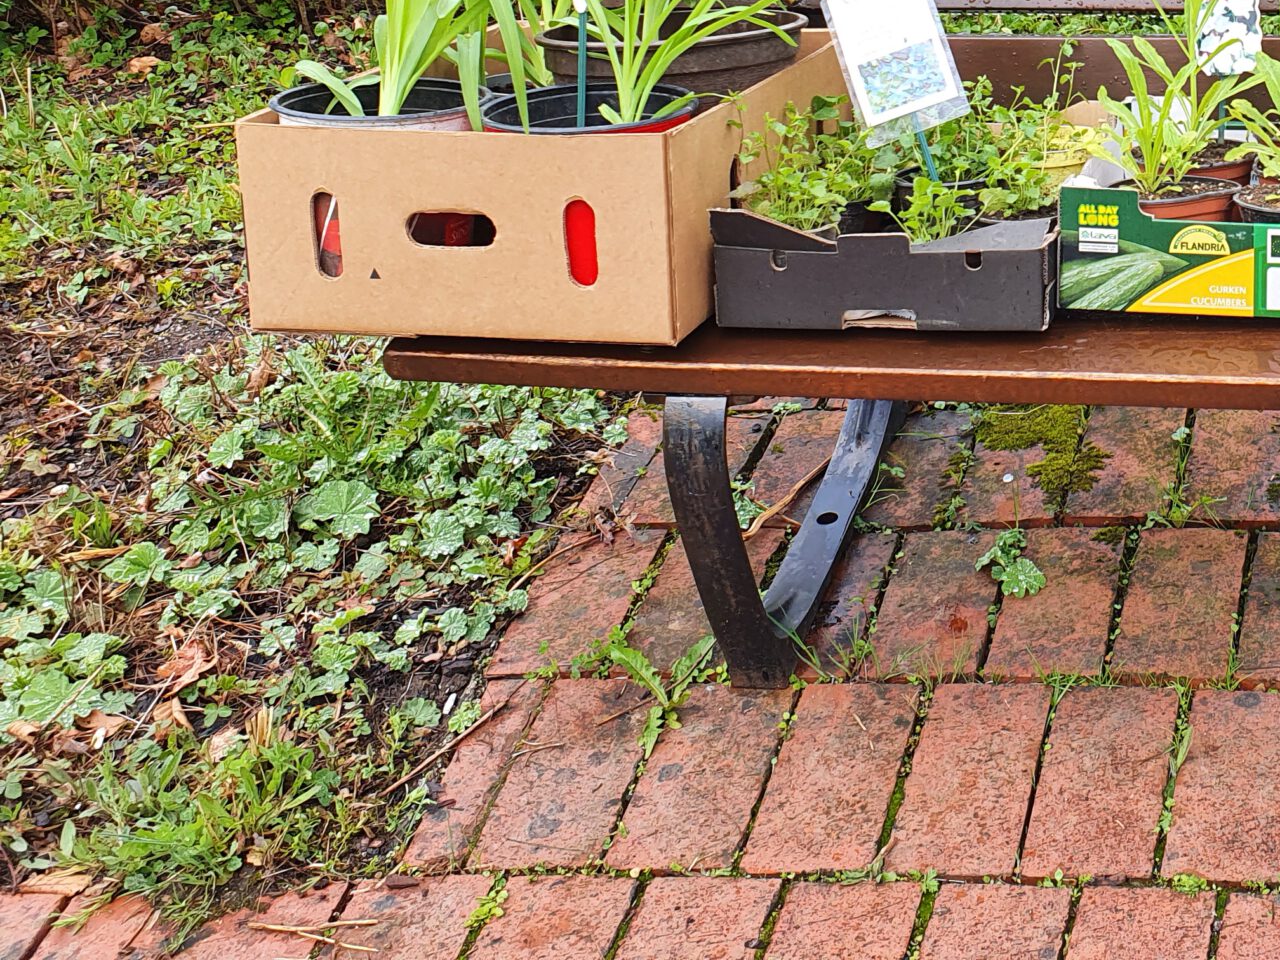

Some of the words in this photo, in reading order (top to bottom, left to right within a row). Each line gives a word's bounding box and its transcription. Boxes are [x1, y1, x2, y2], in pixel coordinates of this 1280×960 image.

[1078, 204, 1097, 213] ALL
[1098, 204, 1119, 214] DAY
[1078, 213, 1119, 227] LONG
[1180, 241, 1226, 252] FLANDRIA
[1208, 285, 1247, 295] GURKEN
[1190, 296, 1247, 307] CUCUMBERS
